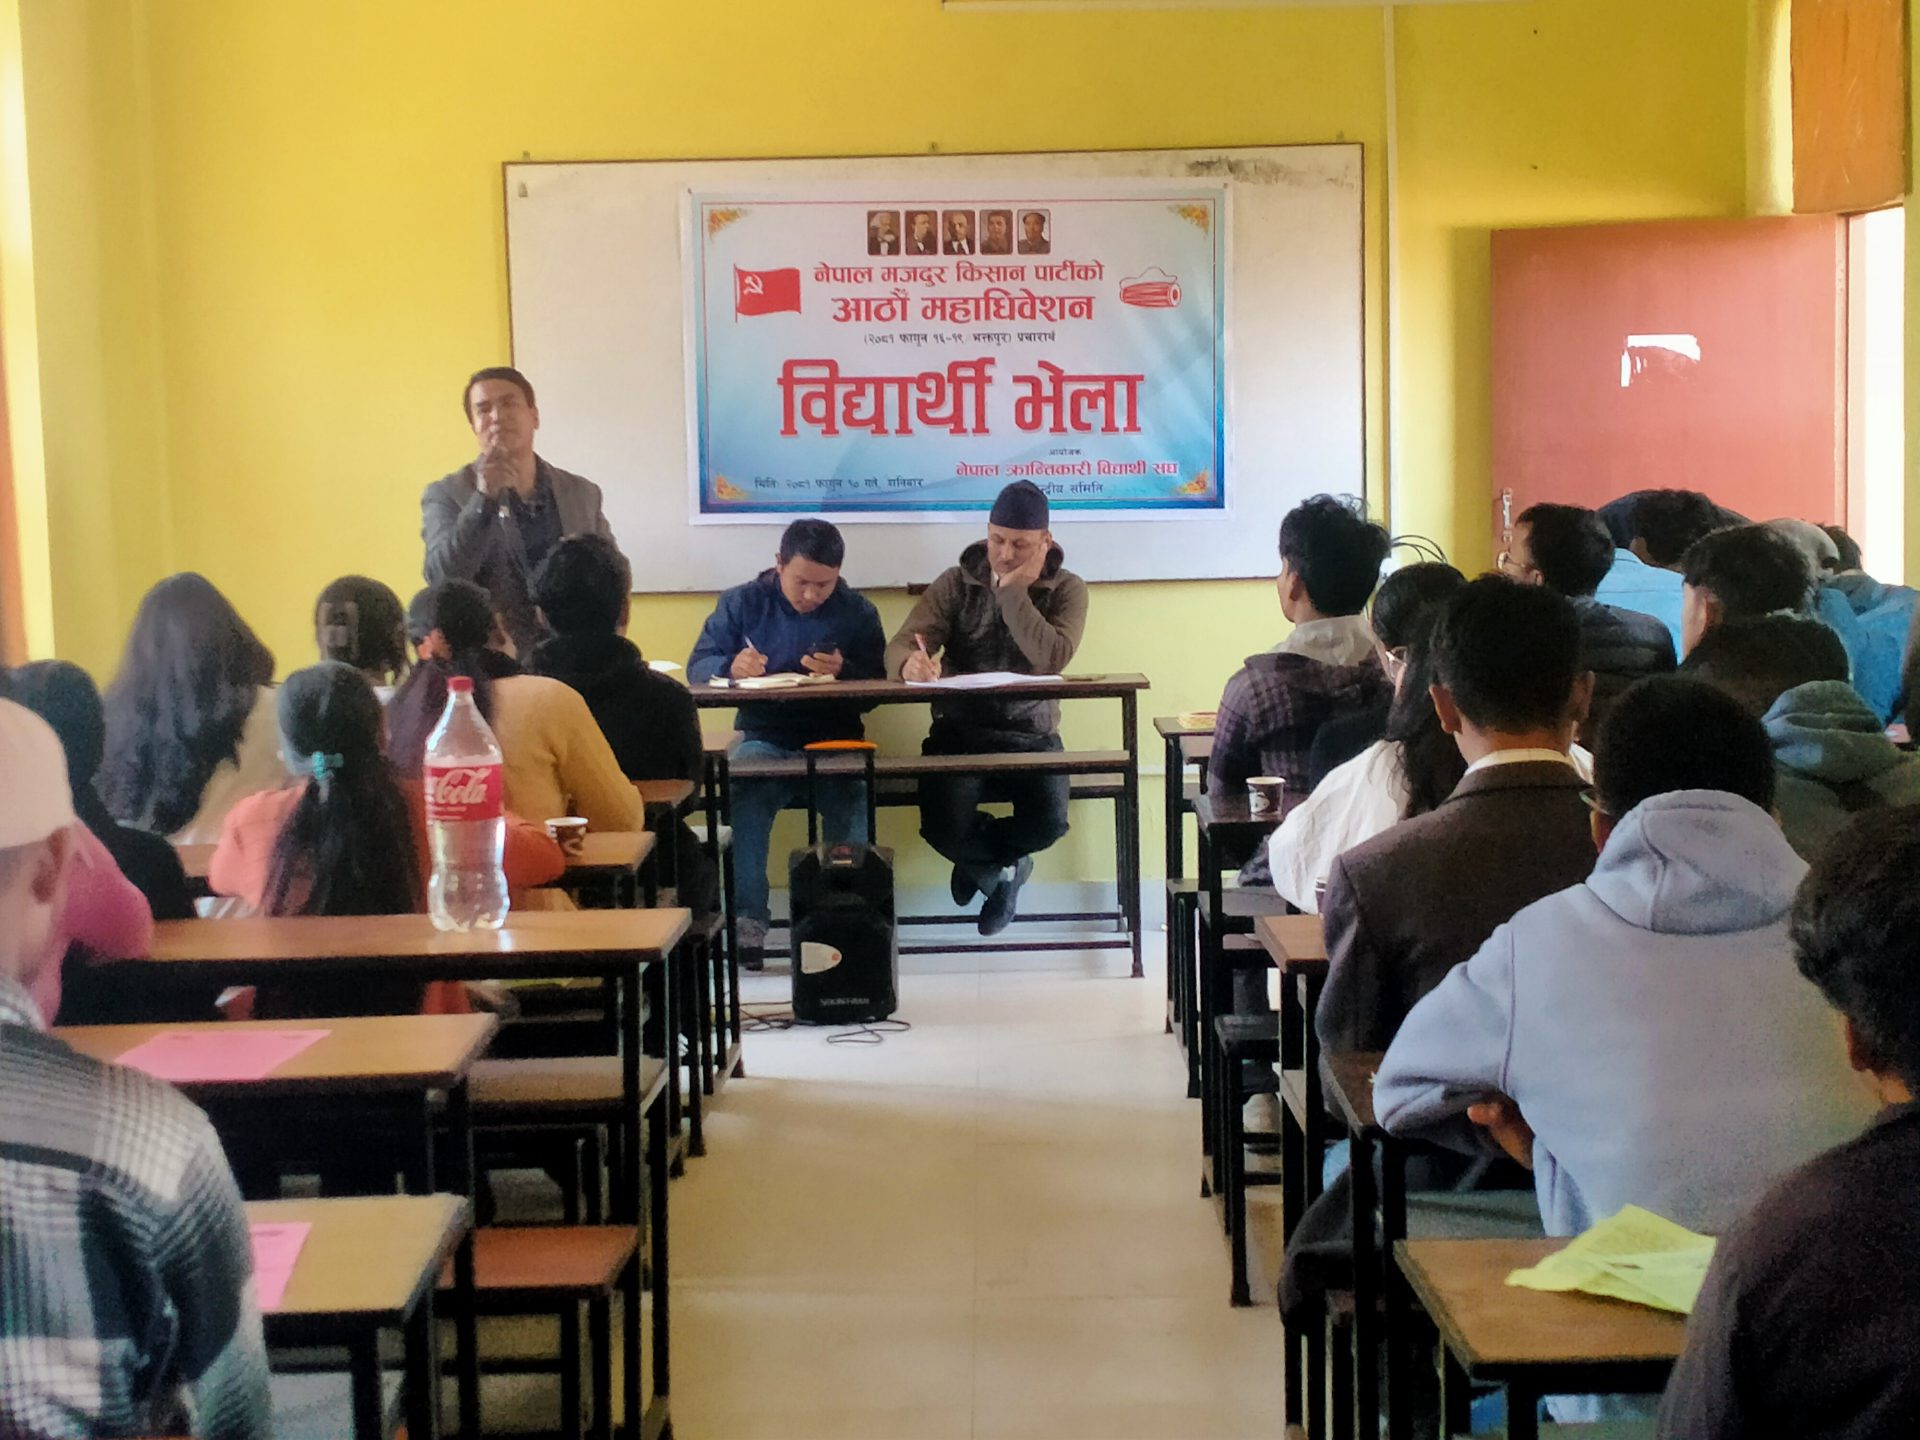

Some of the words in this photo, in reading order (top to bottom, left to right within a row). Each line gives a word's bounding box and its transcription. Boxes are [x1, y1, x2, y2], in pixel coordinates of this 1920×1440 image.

[813, 261, 874, 283] नेपाल
[881, 266, 949, 287] मजदुर
[956, 260, 1026, 282] किसान
[1034, 259, 1105, 282] पार्टीको
[921, 287, 1096, 323] महाधिवेशन
[777, 357, 995, 436] विद्यार्थी
[1012, 360, 1145, 435] भेला
[955, 460, 999, 477] नेपाल
[1005, 460, 1091, 477] क्रान्तिकारी
